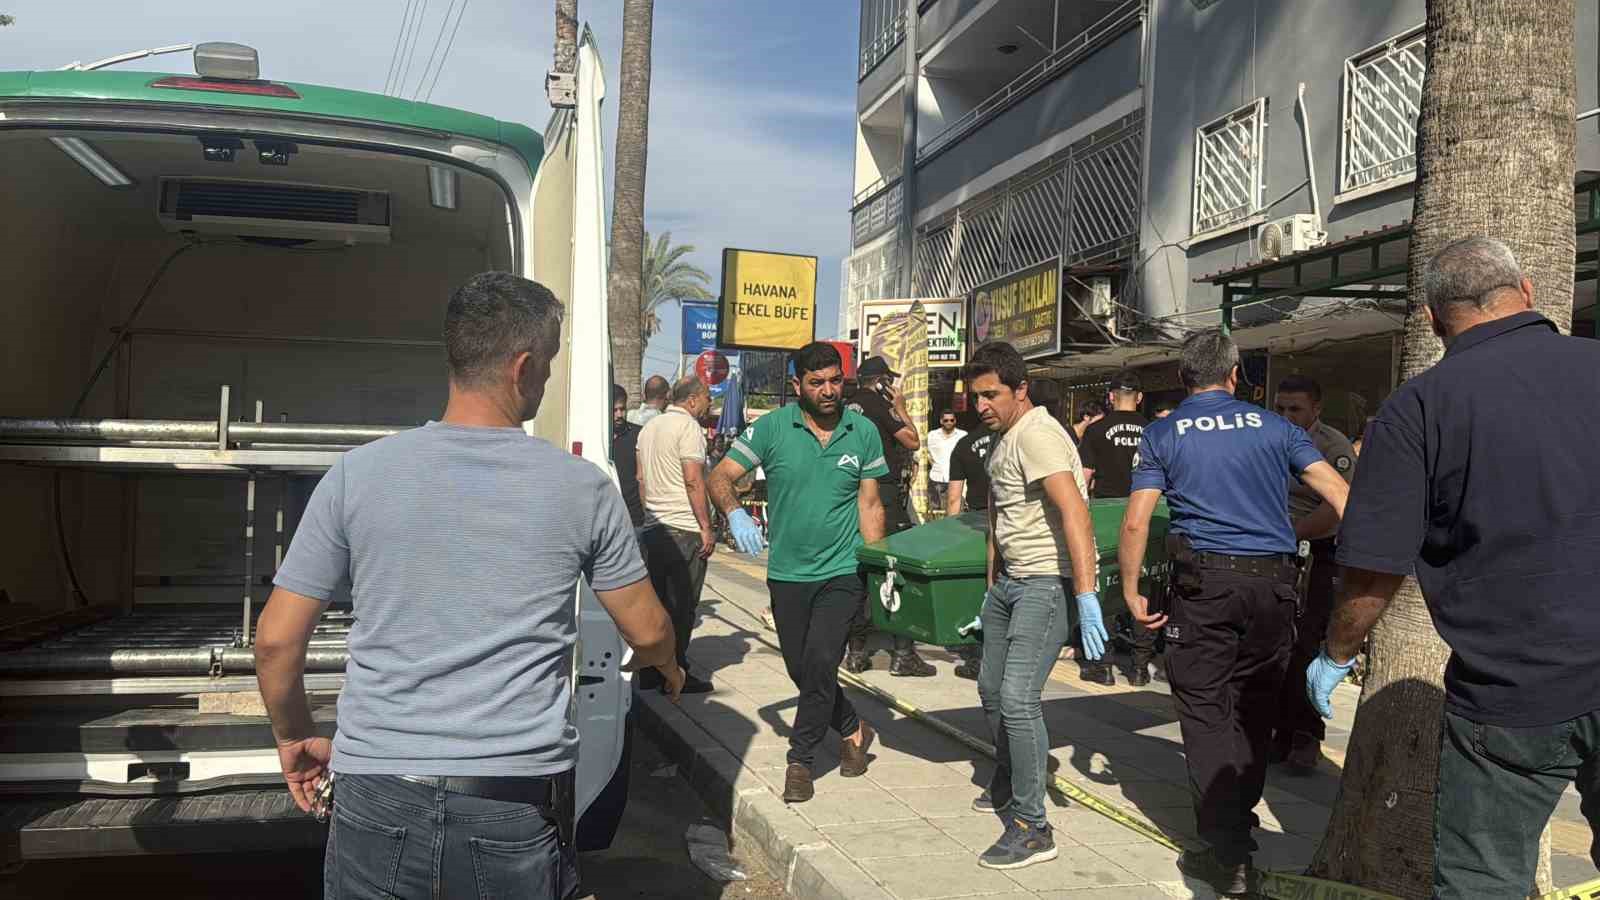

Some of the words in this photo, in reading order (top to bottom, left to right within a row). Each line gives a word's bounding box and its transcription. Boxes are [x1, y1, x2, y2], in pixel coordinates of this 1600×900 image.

[743, 282, 797, 299] HAVANA
[730, 302, 771, 318] TEKEL
[774, 303, 809, 321] BÜFE
[696, 322, 717, 331] HAVA
[865, 311, 958, 337] PEN
[927, 336, 956, 347] EKTRİK
